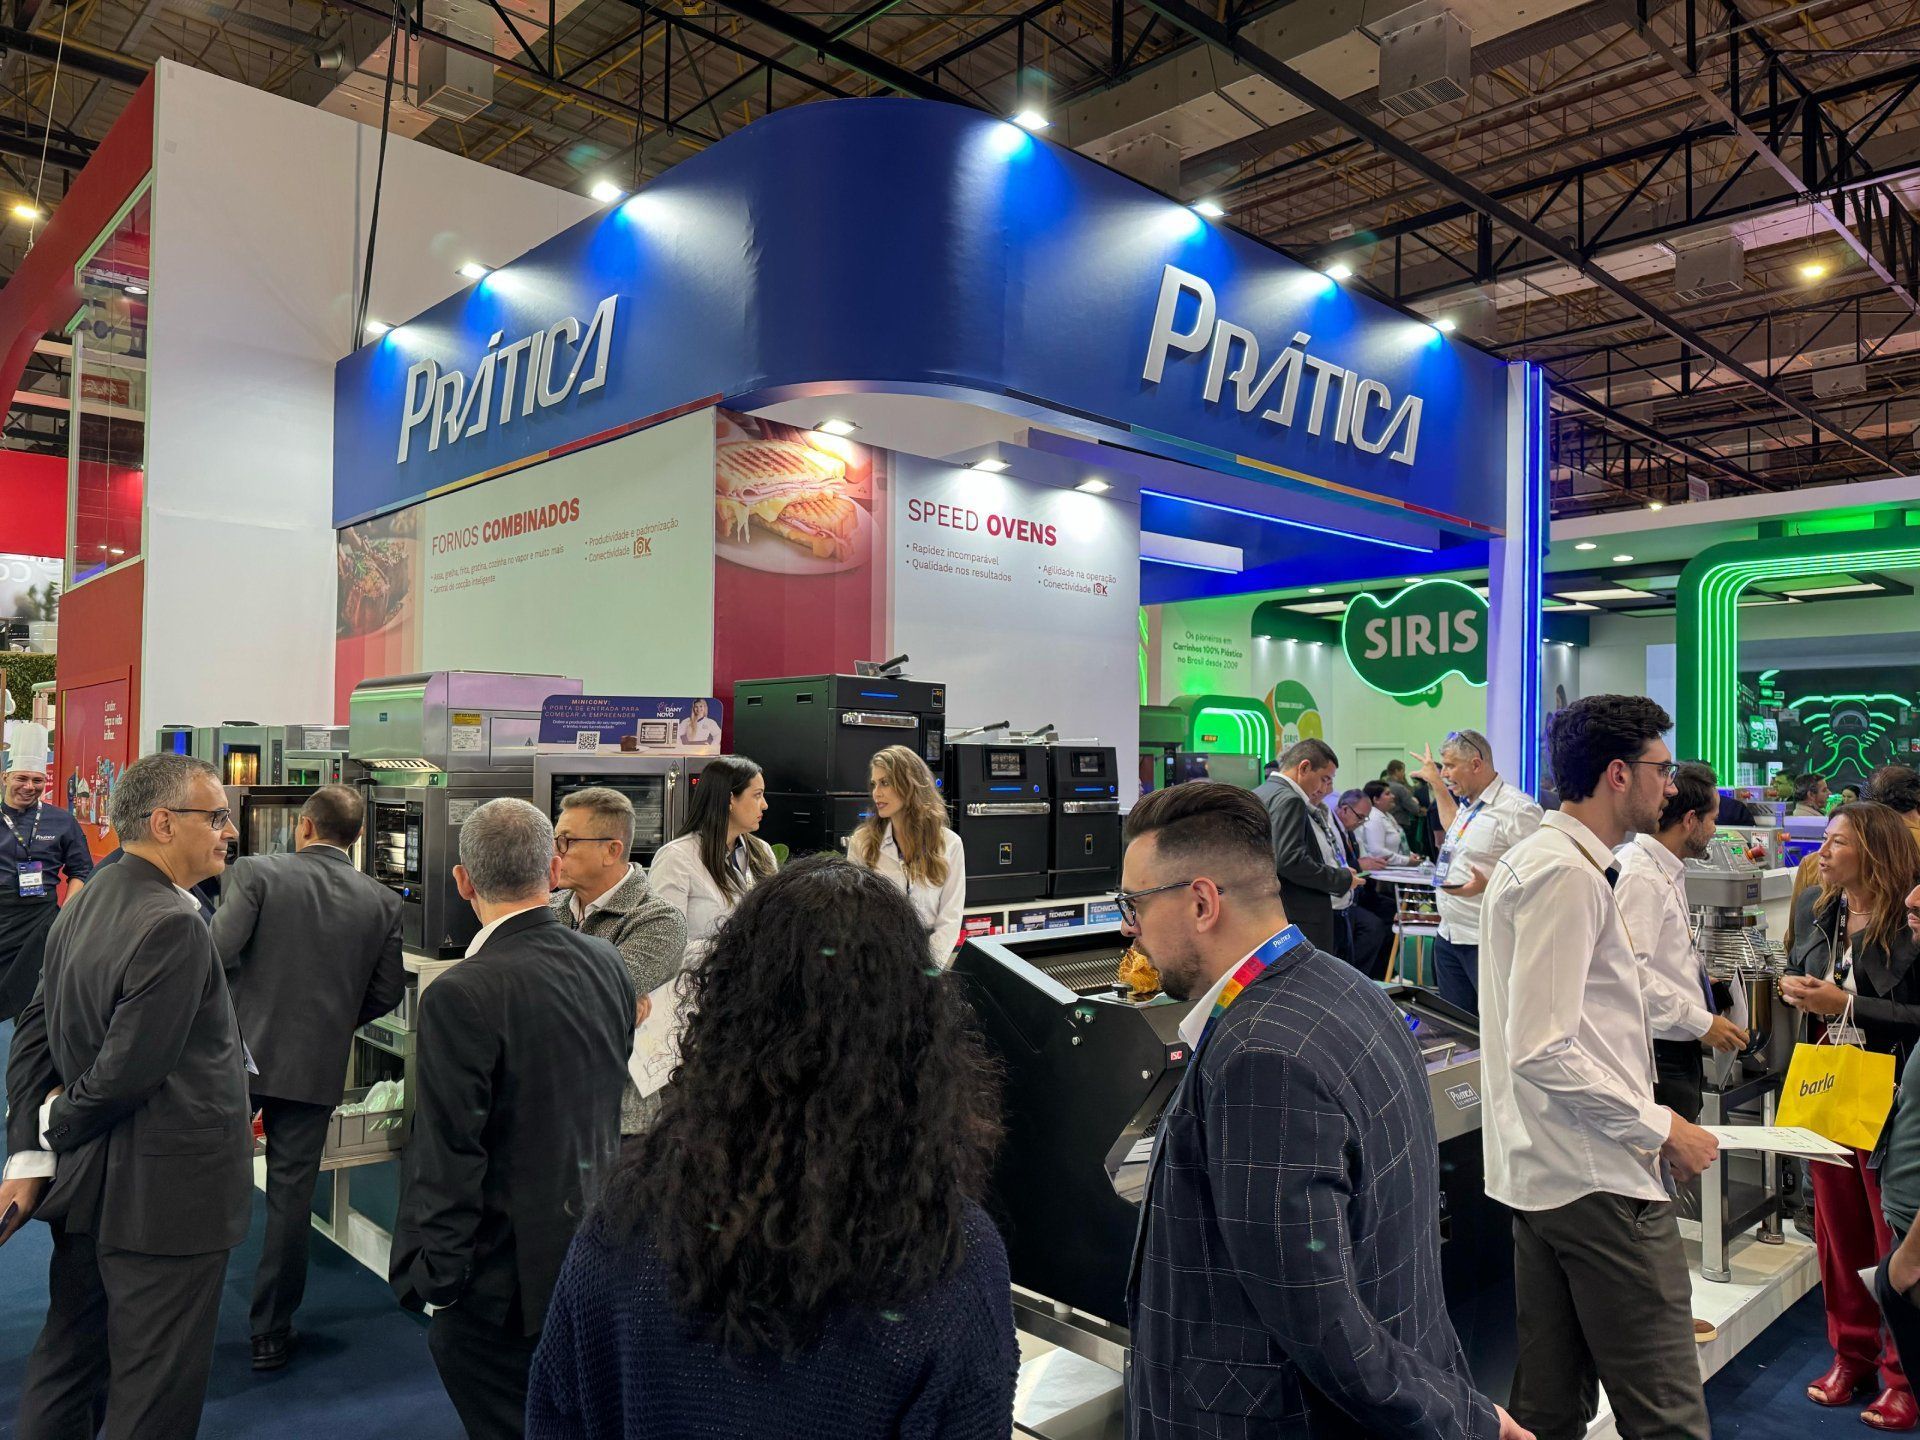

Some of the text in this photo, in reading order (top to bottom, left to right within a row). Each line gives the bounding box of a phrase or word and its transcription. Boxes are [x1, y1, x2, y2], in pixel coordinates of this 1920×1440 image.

[1143, 264, 1423, 466] PRÁTICA
[396, 294, 618, 464] PRÁTICA
[432, 498, 580, 556] FORNOS COMBINADOS
[589, 529, 629, 547] Produtividade
[636, 518, 679, 539] padronização
[908, 498, 1057, 546] SPEED OVENS
[488, 556, 507, 569] cozinha
[508, 556, 514, 564] no
[515, 552, 530, 565] vapor
[534, 548, 550, 558] muito
[551, 544, 564, 555] mais
[588, 545, 630, 562] Conectividade
[912, 542, 1000, 566] Rapidez incomparável
[912, 558, 1012, 582] Qualidade nos resultados
[1043, 565, 1074, 578] Agilidade
[1086, 572, 1116, 584] operação
[1043, 578, 1091, 594] Conectividade
[1185, 630, 1194, 640] Os
[1196, 634, 1222, 643] pioneiros
[1364, 610, 1478, 660] SIRIS
[1173, 642, 1242, 658] Carrinhos 100% Plástico
[1187, 656, 1204, 665] Brasil
[1205, 659, 1222, 668] desde
[1224, 660, 1238, 670] 2009
[1800, 1073, 1835, 1097] barla
